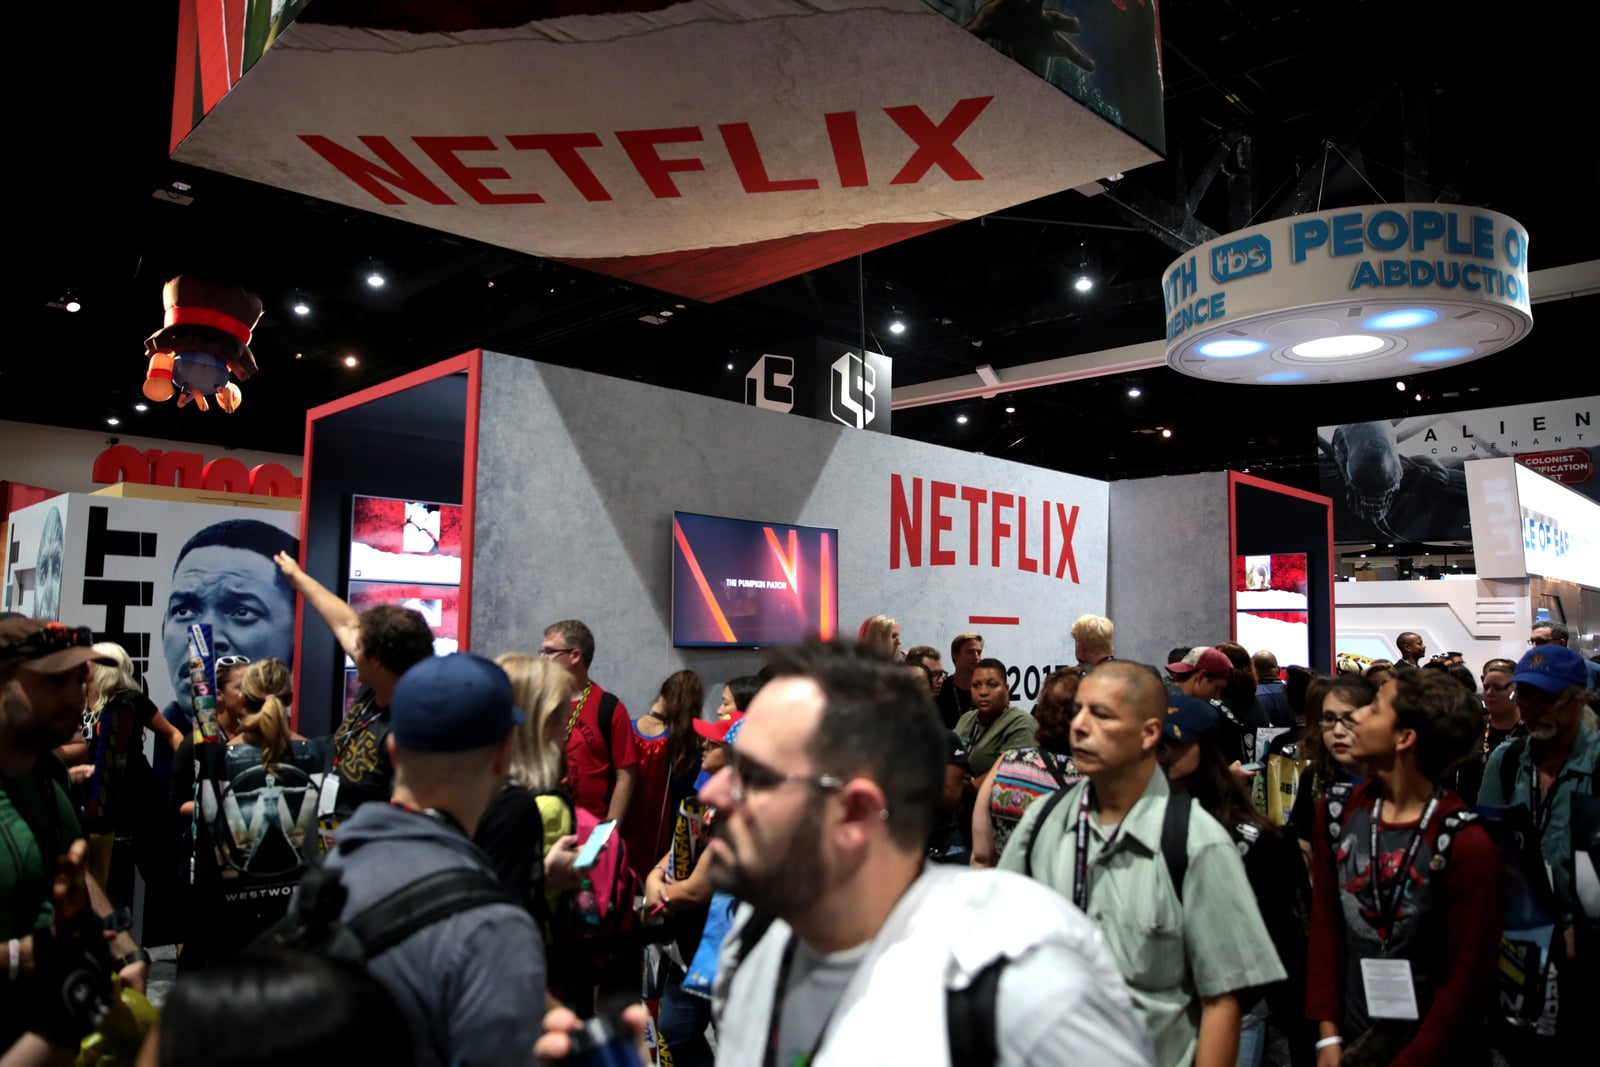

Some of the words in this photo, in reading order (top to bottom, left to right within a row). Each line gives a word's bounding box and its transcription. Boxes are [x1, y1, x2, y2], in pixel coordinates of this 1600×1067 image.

[296, 95, 995, 205] NETFLIX
[1291, 210, 1495, 263] PEOPLE
[1216, 245, 1267, 276] tbs
[1424, 411, 1591, 443] ALIEN
[1431, 434, 1584, 455] COVENANT
[1525, 455, 1575, 466] COLONIST
[1535, 463, 1588, 473] IFICATION
[890, 473, 1080, 585] NETFLIX
[726, 578, 737, 587] THE
[738, 579, 766, 589] PUMPKIN
[767, 581, 787, 590] PATCH
[225, 885, 299, 902] WESTWO
